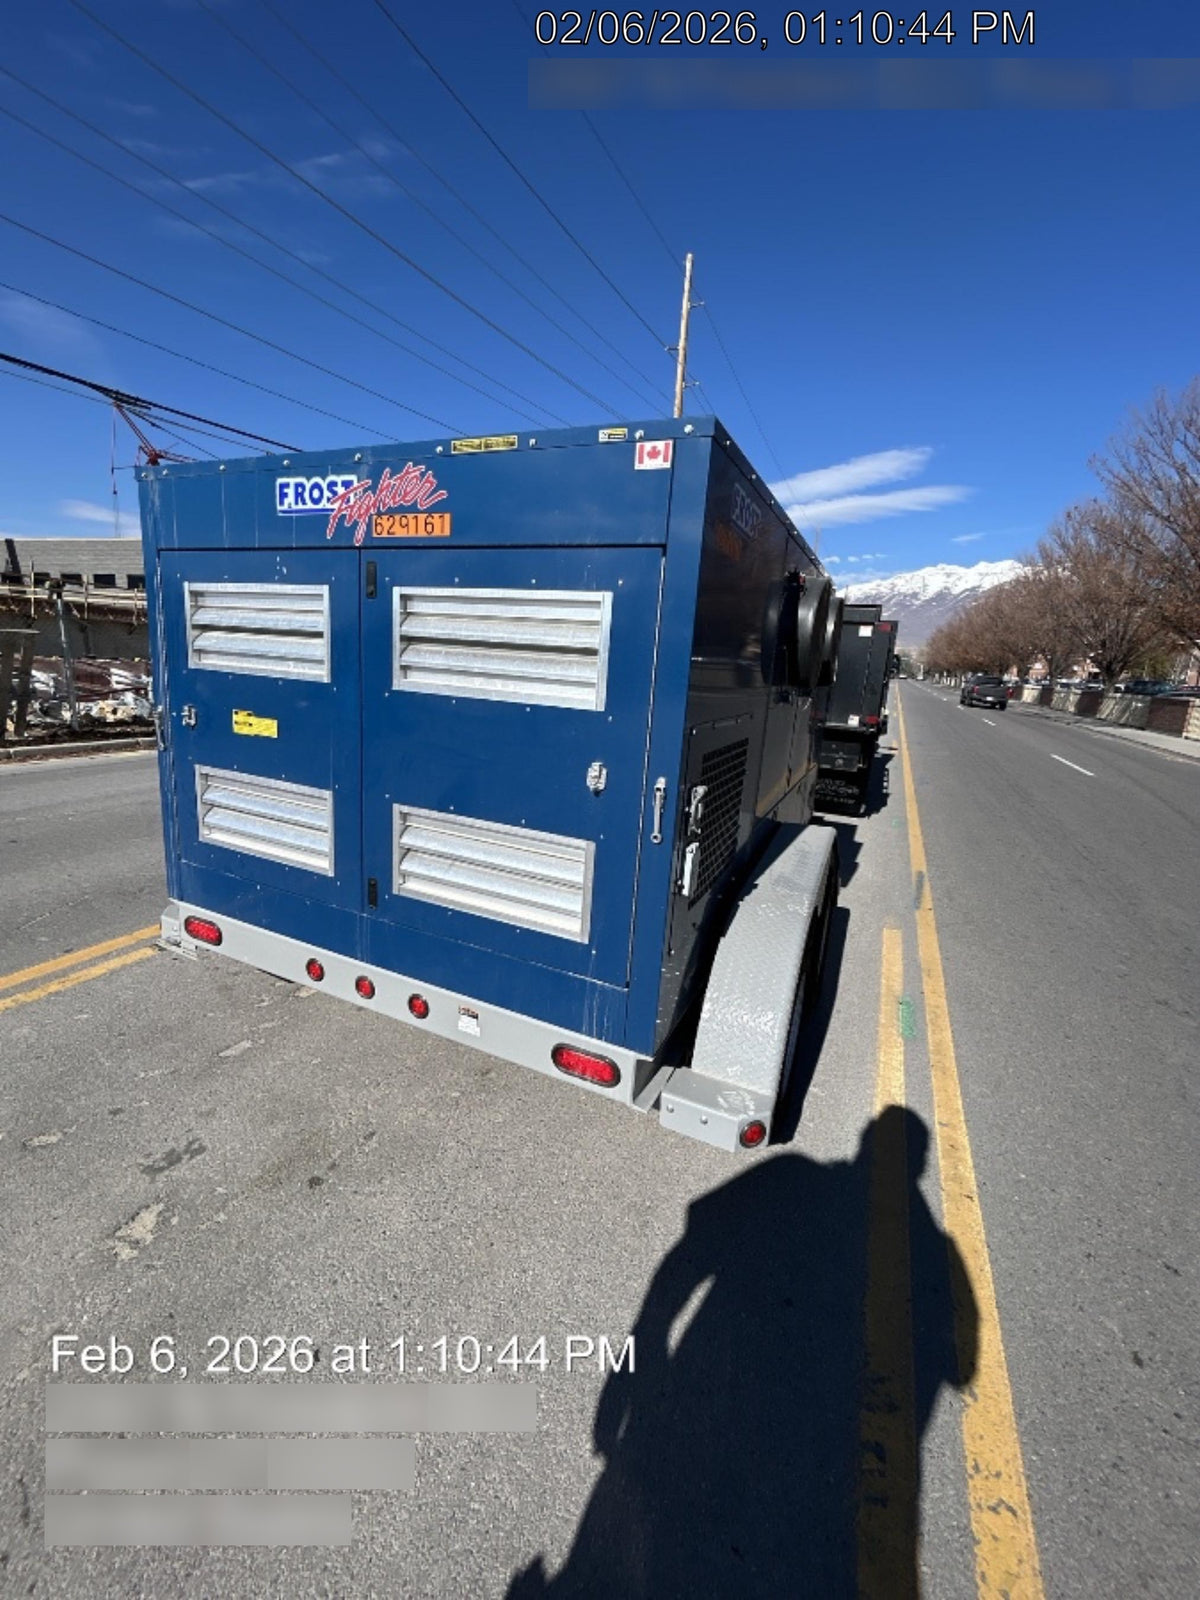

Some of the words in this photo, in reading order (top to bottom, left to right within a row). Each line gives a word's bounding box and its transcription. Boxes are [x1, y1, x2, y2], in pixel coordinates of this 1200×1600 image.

[277, 478, 356, 510] FROST
[326, 462, 448, 546] Fighter
[373, 514, 448, 536] 629161
